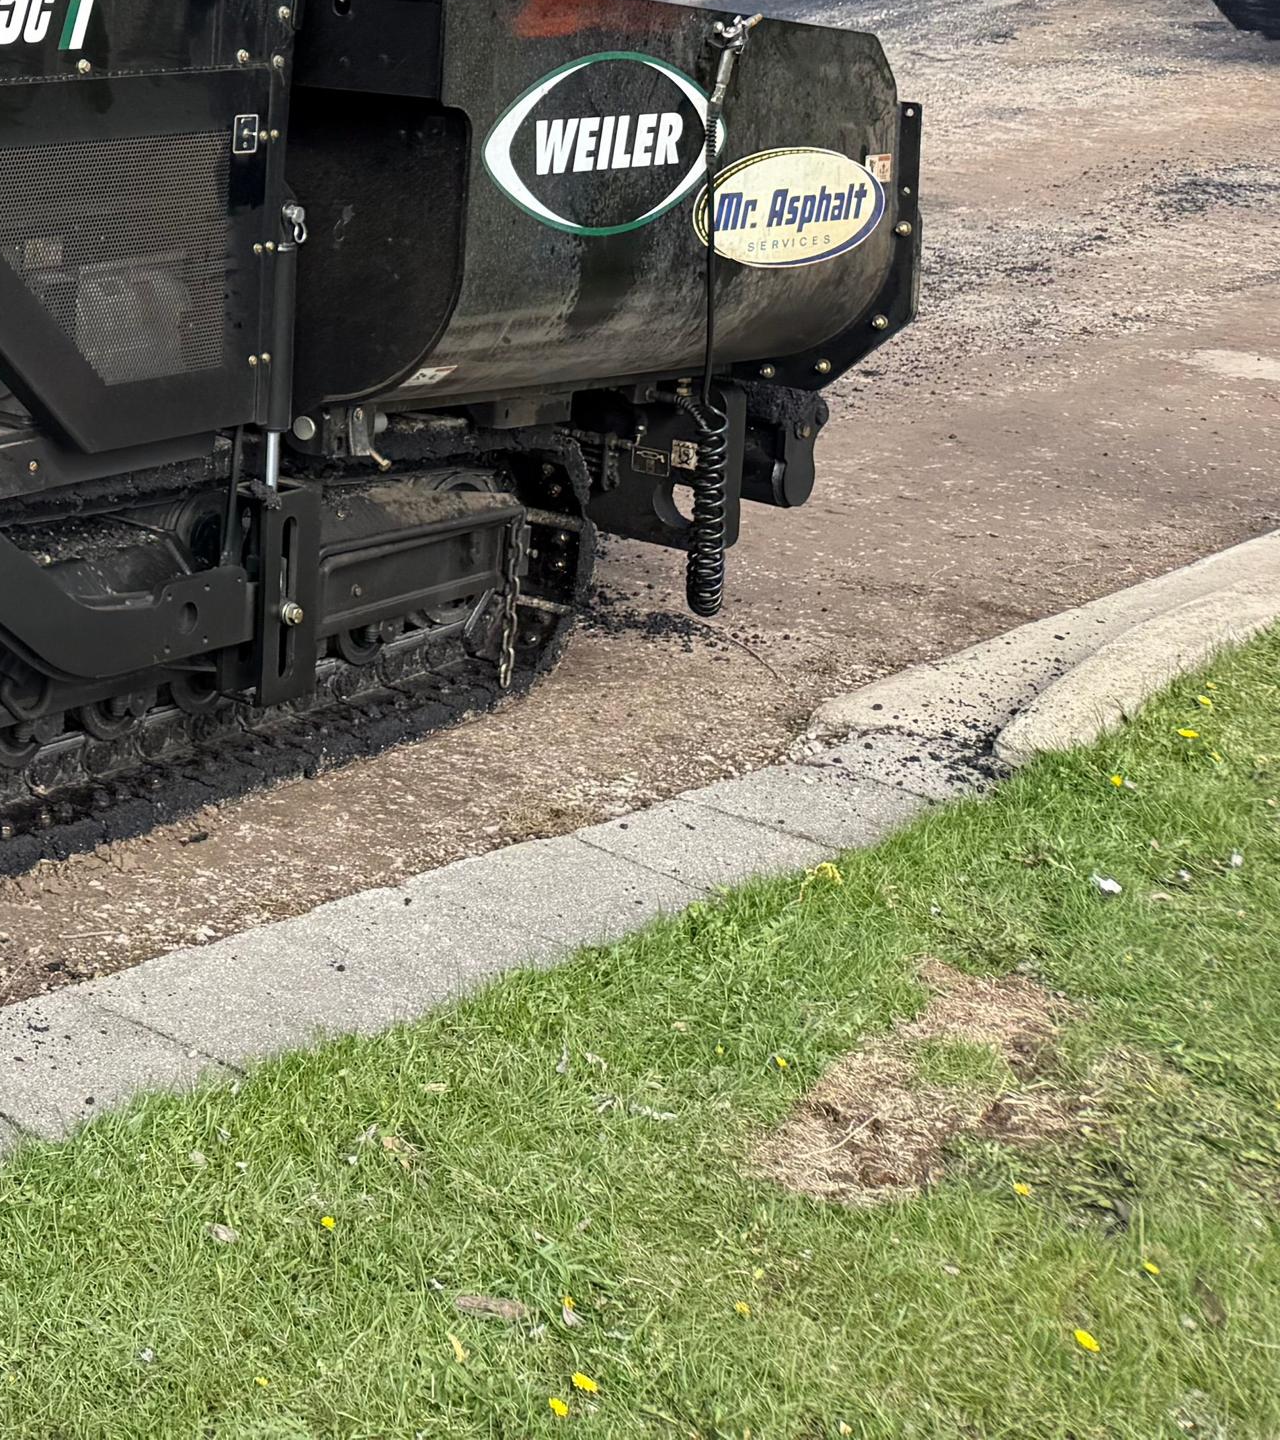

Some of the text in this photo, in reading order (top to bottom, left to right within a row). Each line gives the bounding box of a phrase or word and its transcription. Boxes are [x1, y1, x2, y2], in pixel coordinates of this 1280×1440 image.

[536, 112, 683, 175] WEILER
[714, 183, 868, 232] Mr. Asphalt
[748, 234, 832, 252] SERVICES
